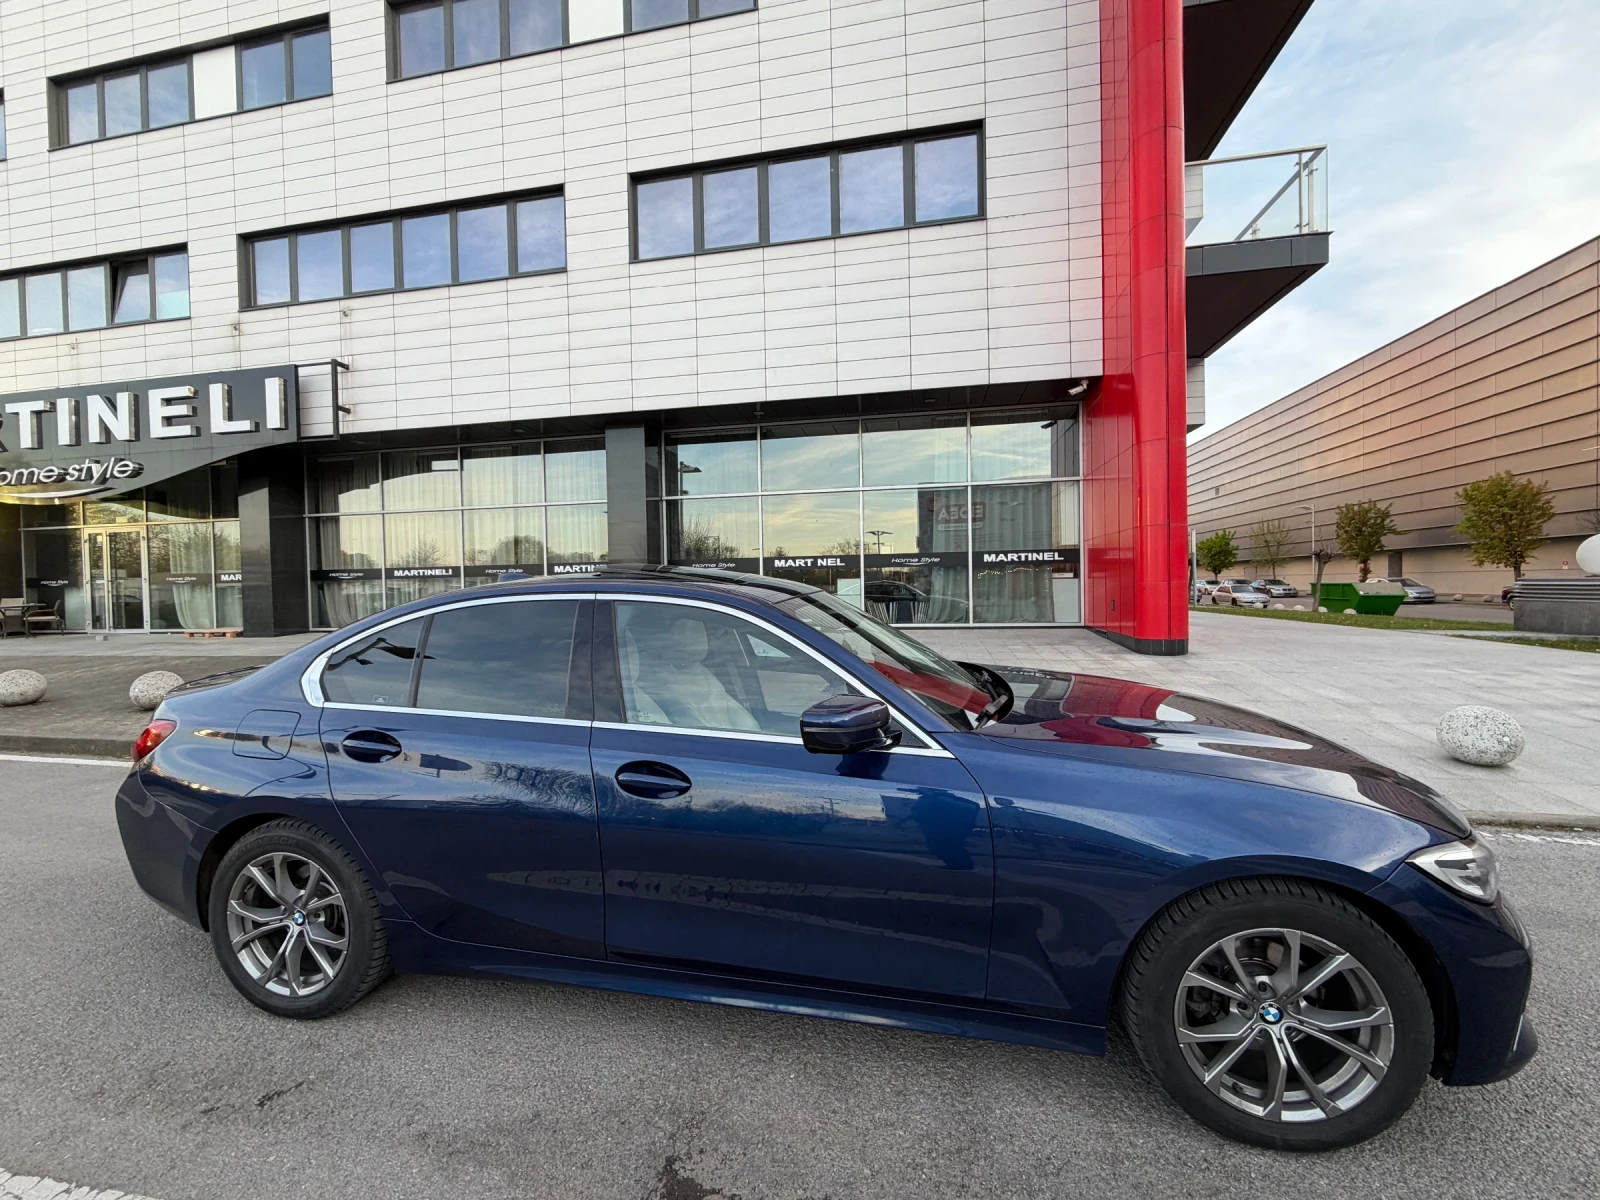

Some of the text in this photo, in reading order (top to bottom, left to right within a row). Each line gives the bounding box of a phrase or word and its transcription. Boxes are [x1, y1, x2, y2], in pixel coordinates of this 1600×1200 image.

[0, 376, 287, 450] TINELI
[66, 456, 135, 485] style
[920, 555, 941, 564] Style
[983, 551, 1065, 563] MARTINEL
[717, 561, 736, 569] Style
[393, 568, 453, 577] MARTINELI
